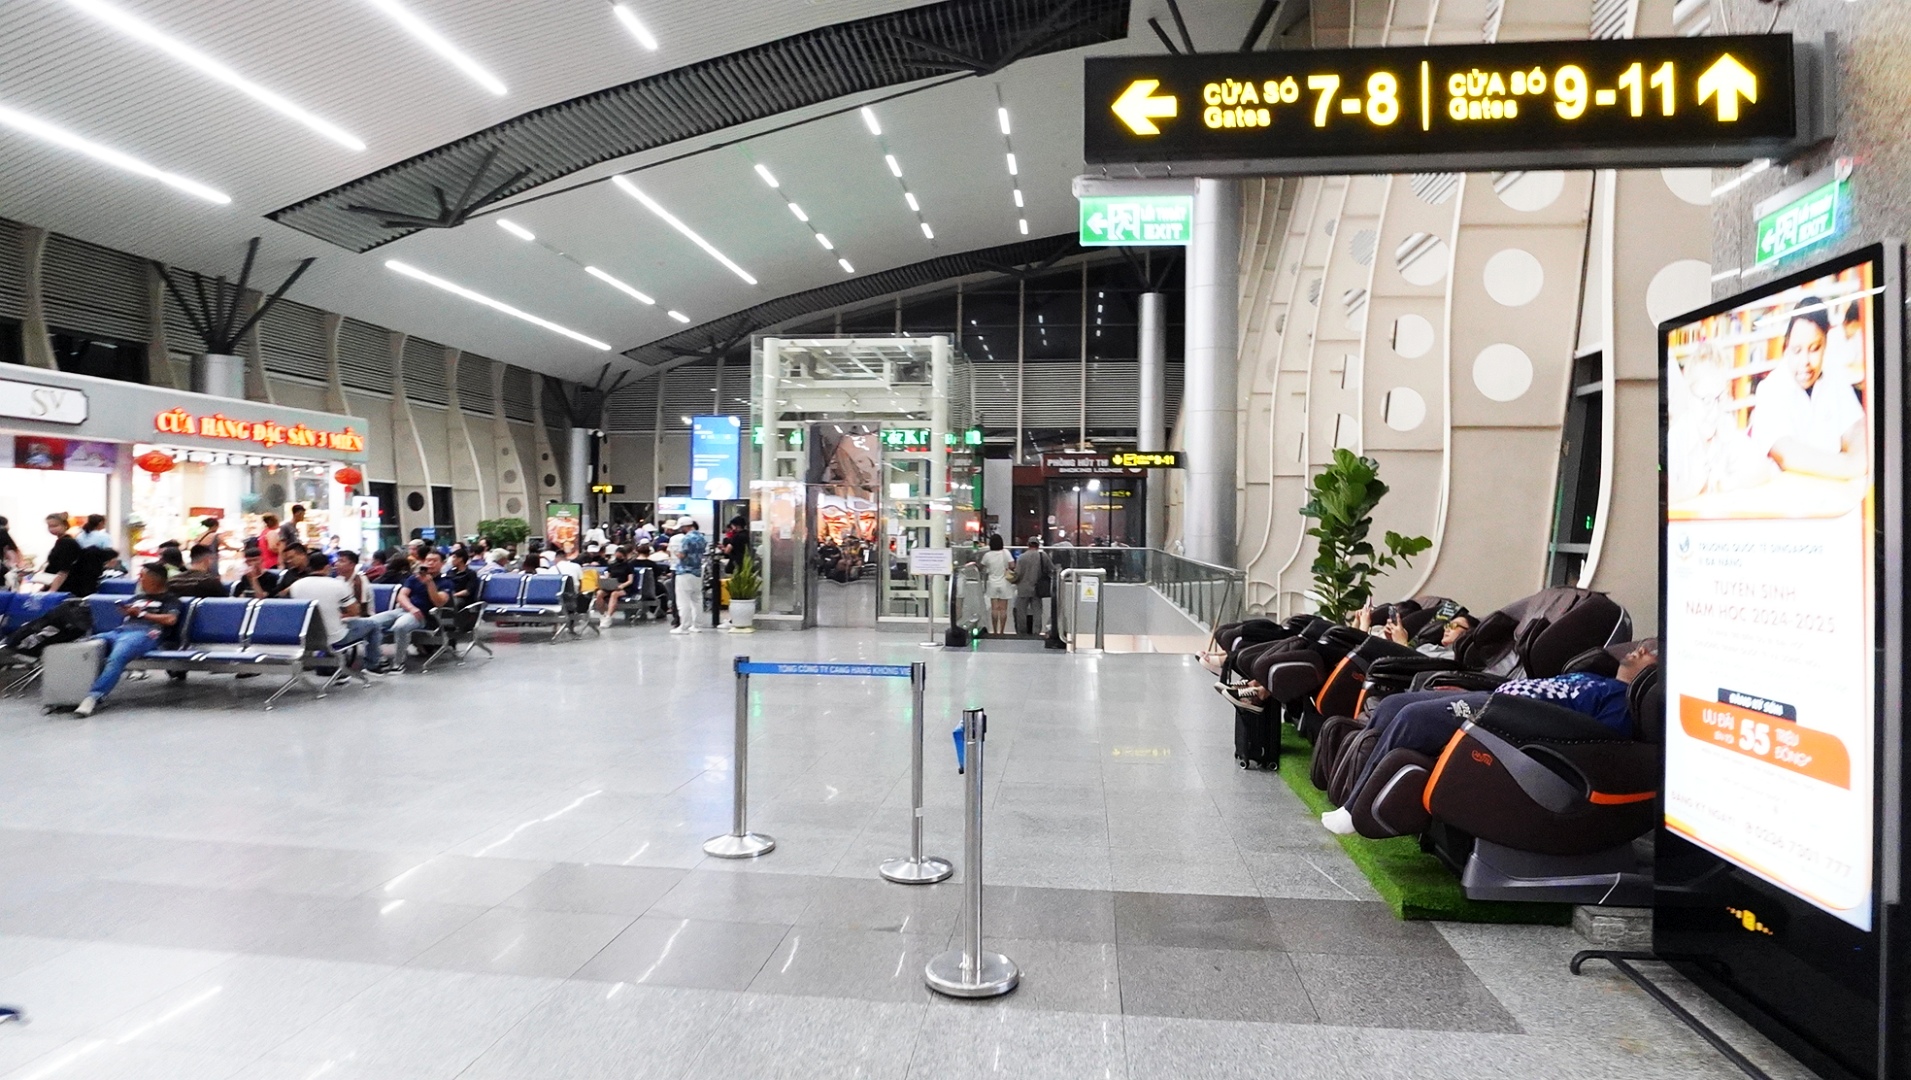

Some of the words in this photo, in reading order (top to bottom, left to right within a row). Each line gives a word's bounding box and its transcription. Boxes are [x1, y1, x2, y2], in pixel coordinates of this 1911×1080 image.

[1307, 71, 1399, 128] 7-8
[1554, 61, 1675, 120] 9-11
[1204, 106, 1271, 128] Gates
[1449, 97, 1518, 120] Gates
[1143, 223, 1183, 240] EXIT
[317, 432, 328, 447] 3
[1761, 583, 1797, 602] SINH
[1752, 607, 1837, 634] 2024-2025
[1738, 718, 1771, 756] 55
